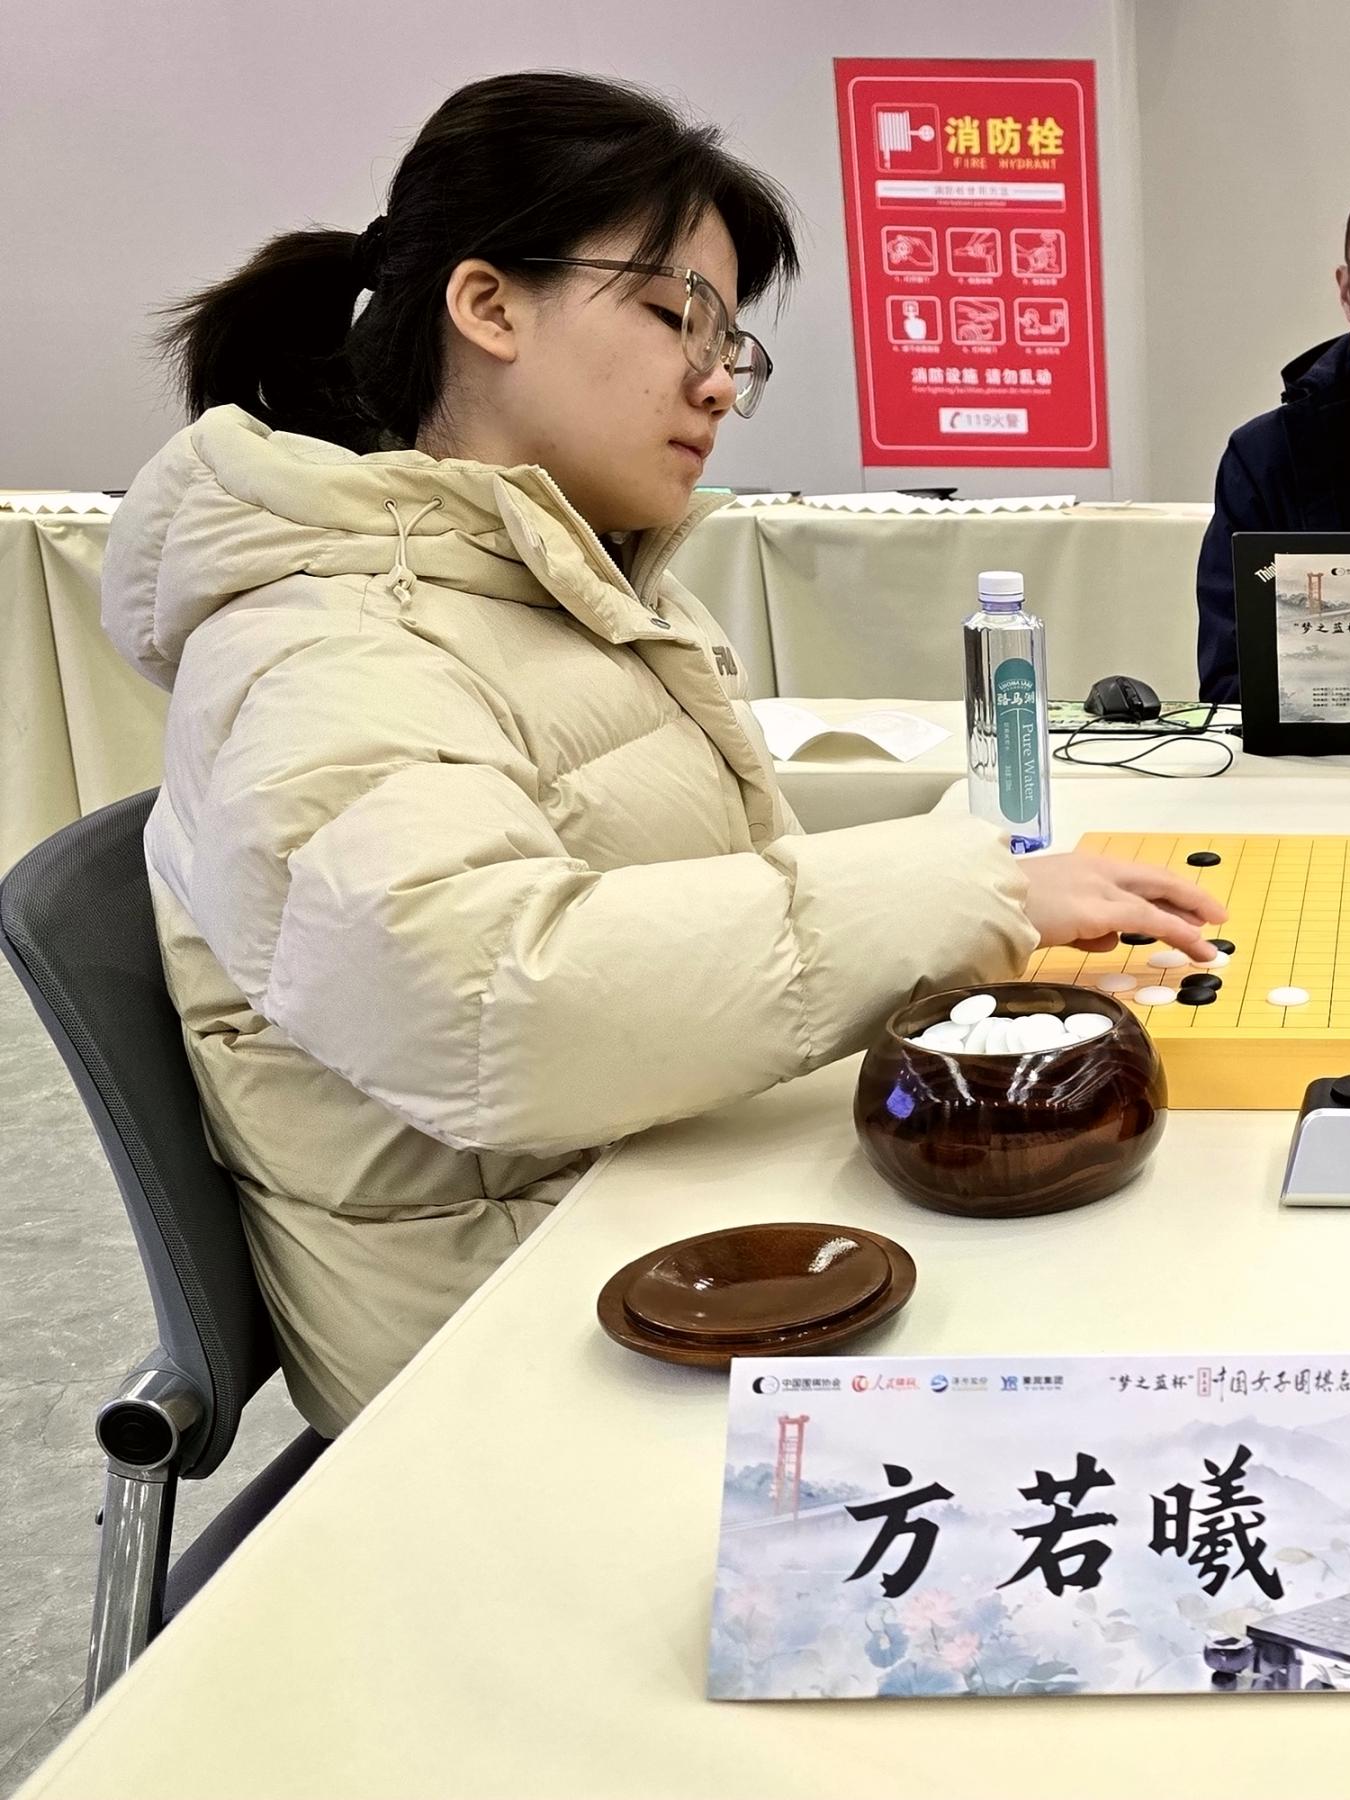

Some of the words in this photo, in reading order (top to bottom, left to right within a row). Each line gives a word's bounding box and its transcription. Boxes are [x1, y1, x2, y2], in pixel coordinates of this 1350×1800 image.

[944, 115, 1064, 156] 消防栓
[953, 157, 987, 169] FIRE
[911, 367, 979, 386] 消防设施
[1022, 722, 1034, 757] Pure
[1023, 760, 1036, 801] Water
[846, 1445, 1283, 1600] 方若曦
